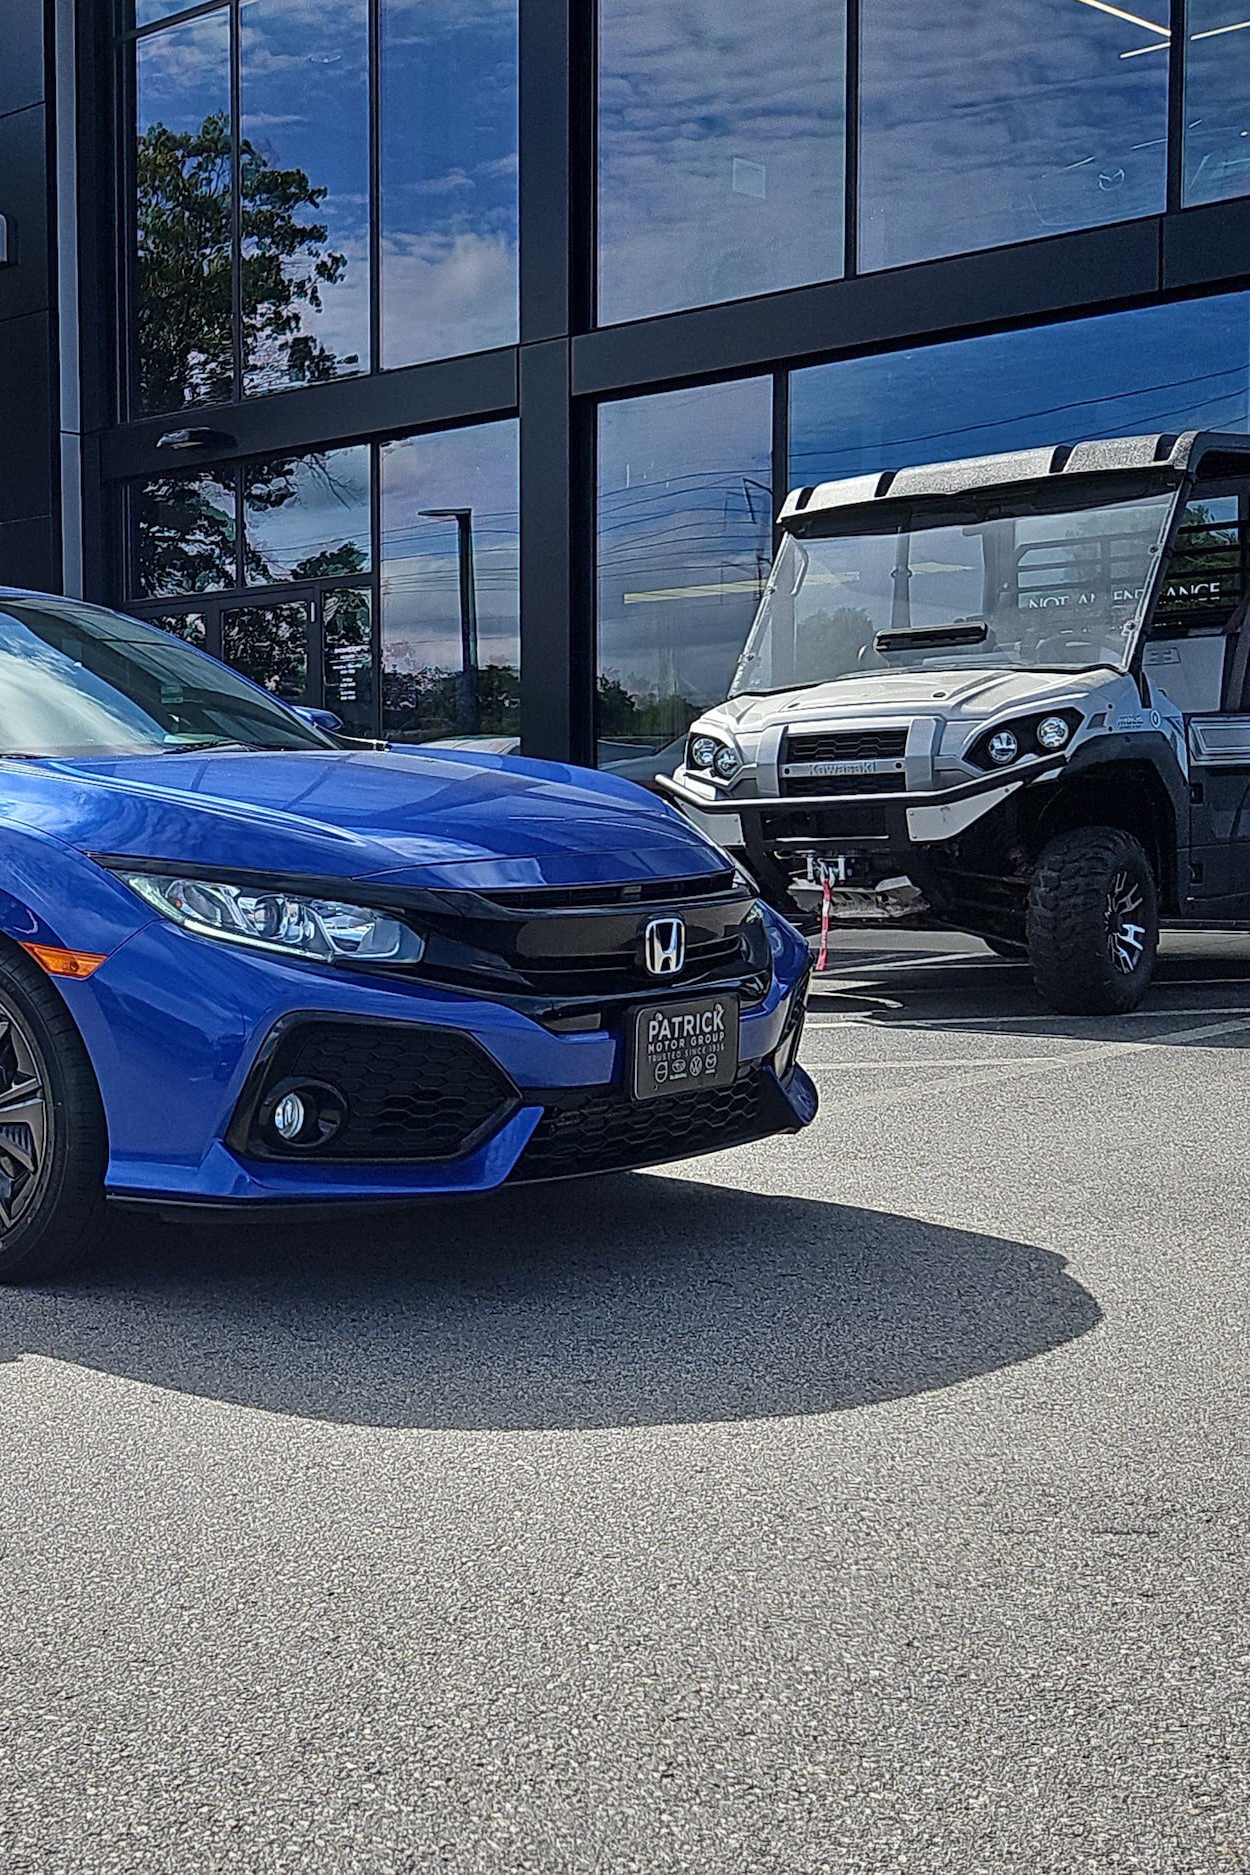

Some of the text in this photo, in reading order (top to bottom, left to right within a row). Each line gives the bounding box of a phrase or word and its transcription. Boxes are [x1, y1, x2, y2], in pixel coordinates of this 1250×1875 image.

[648, 1009, 725, 1042] PATRICK
[648, 1031, 725, 1055] MOTOR GROUP
[648, 1051, 682, 1065] TRUSTED
[684, 1046, 706, 1058] SINCE
